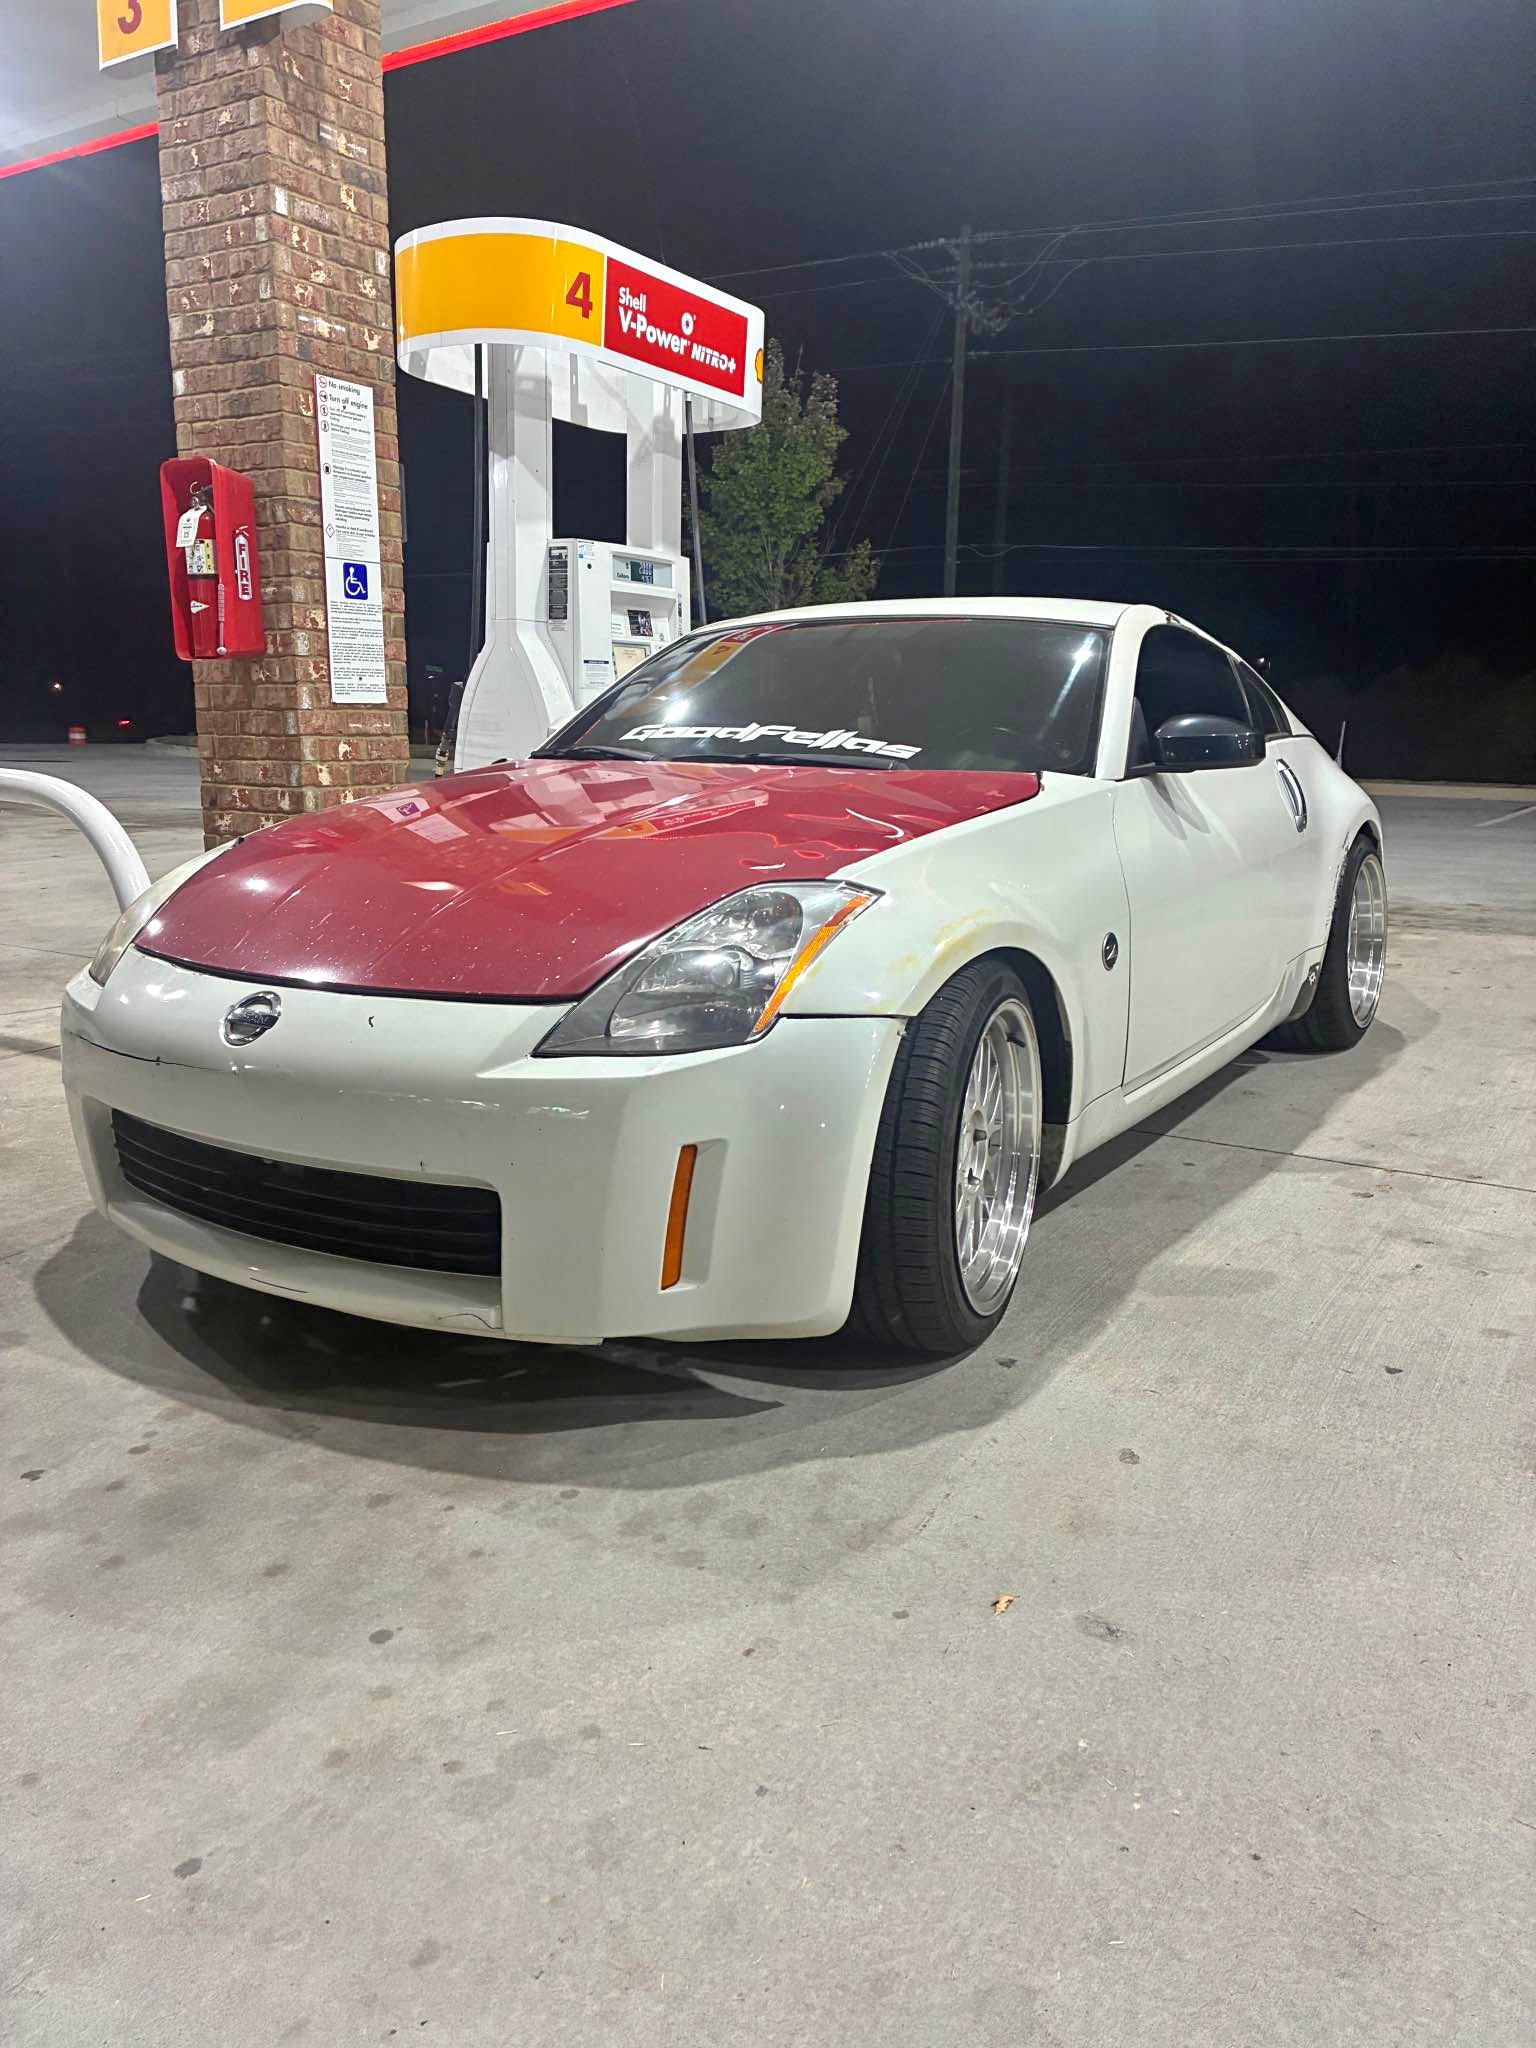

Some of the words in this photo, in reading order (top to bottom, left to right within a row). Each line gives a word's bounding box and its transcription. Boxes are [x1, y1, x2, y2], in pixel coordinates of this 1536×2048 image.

[565, 272, 593, 320] 4
[618, 286, 647, 313] Shell
[618, 306, 687, 355] V-Power
[329, 380, 337, 389] No
[338, 384, 361, 396] smoking
[329, 394, 341, 404] Turn
[342, 397, 350, 405] off
[350, 401, 369, 410] engine
[238, 543, 250, 596] FIRE
[619, 722, 923, 759] GoodFellas
